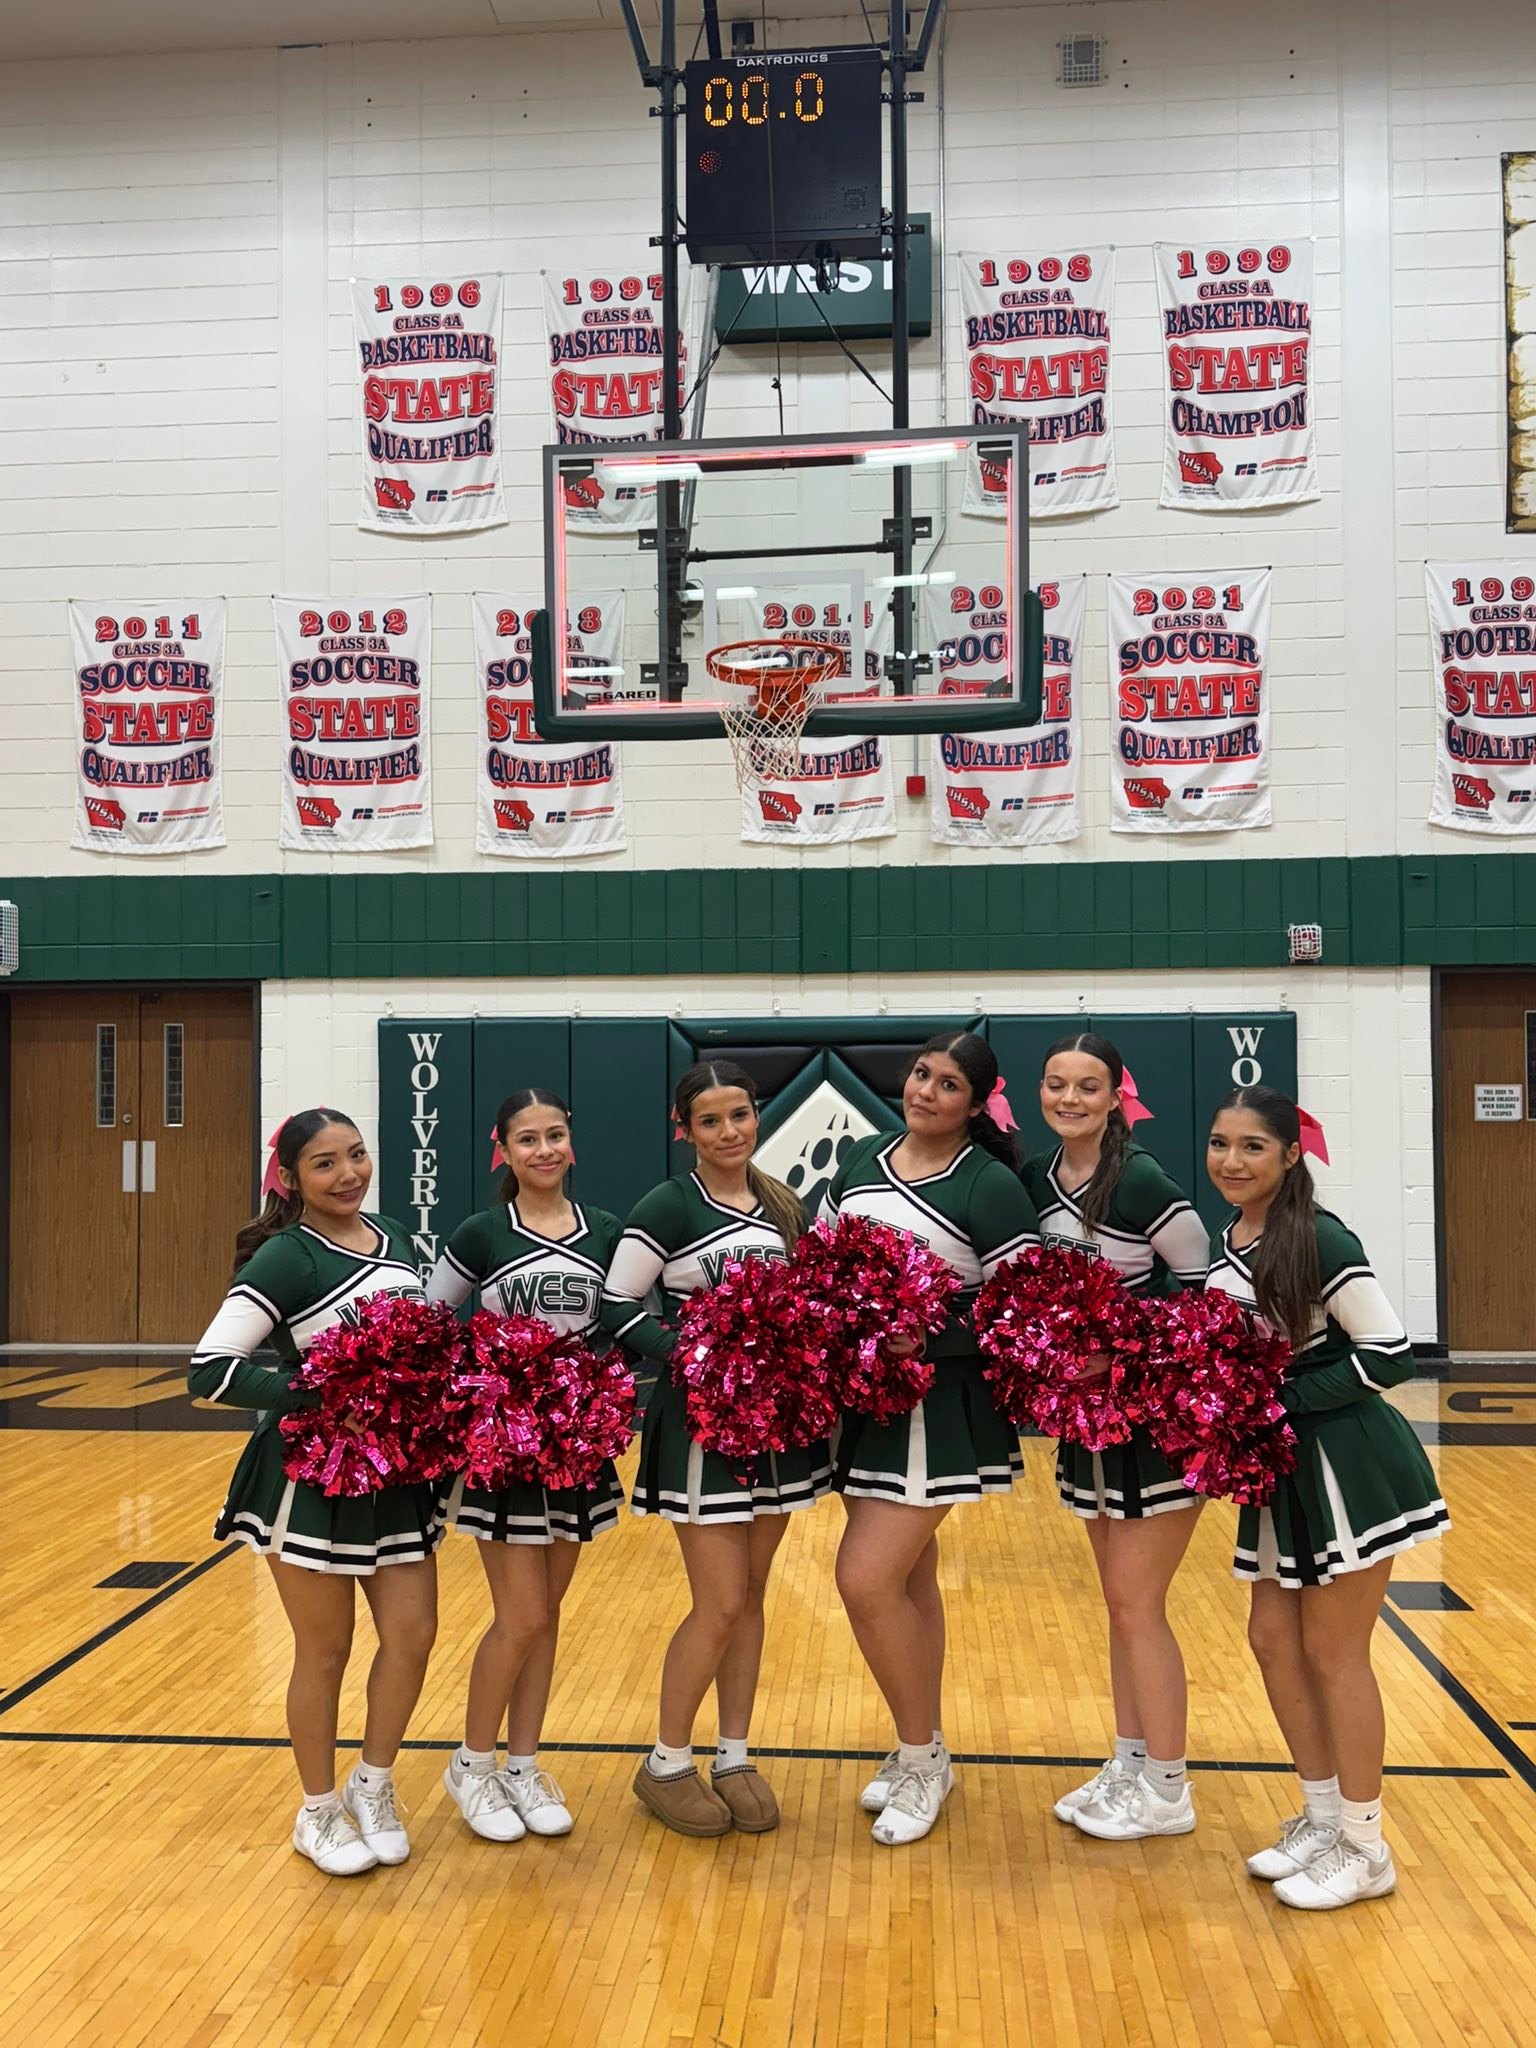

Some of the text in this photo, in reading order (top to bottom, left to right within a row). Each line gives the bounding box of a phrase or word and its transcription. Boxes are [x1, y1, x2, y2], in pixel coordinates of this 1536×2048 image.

[736, 54, 828, 67] DAKTRONICS
[705, 73, 823, 126] 00.0
[980, 254, 1092, 287] 1998
[1177, 246, 1291, 279] 1999
[374, 280, 481, 312] 1996
[1000, 288, 1074, 308] CLASS 4A
[1197, 279, 1273, 299] CLASS 4A
[393, 313, 464, 333] CLASS 4A
[582, 307, 654, 326] CLASS 4A
[966, 307, 1110, 350] BASKETBALL
[1164, 300, 1311, 340] BASKETBALL
[360, 333, 497, 373] BASKETBALL
[550, 327, 687, 366] BASKETBA
[969, 346, 1109, 402] STATE
[1168, 338, 1309, 394] STATE
[363, 369, 494, 422] STATE
[1170, 389, 1307, 438] CHAMPION
[368, 418, 494, 464] QUALIFIER
[982, 462, 1008, 484] IHSA
[1182, 453, 1215, 481] IHSAA
[378, 480, 408, 507] IHSAA
[569, 483, 596, 505] HSAA
[951, 582, 1060, 613] 205
[1133, 584, 1244, 616] 2021
[95, 614, 202, 642] 2011
[300, 609, 408, 638] 2012
[970, 611, 1008, 629] CLAS
[1152, 613, 1227, 631] CLASS 3A
[1470, 605, 1521, 624] CLASS
[112, 641, 185, 659] CLASS 3A
[318, 636, 390, 653] CLASS 3A
[1118, 631, 1262, 676] SOCCER
[79, 660, 213, 697] SOCCER
[290, 655, 420, 692] SOCCER
[603, 690, 657, 700] GARED
[1118, 671, 1262, 722] STATE
[83, 696, 215, 746] STATE
[288, 694, 421, 743] STATE
[940, 727, 1073, 774] QUALIFIER
[1118, 720, 1262, 767] QUALIFIER
[81, 745, 213, 788] QUALIFIER
[289, 743, 421, 787] QUALIFIER
[487, 743, 614, 789] QUALIFIER
[762, 792, 793, 820] IHSAA
[950, 788, 982, 816] IHSAA
[1127, 780, 1162, 807] IHSAA
[1455, 776, 1487, 805] IHSAA
[87, 799, 121, 827] IHSAA
[300, 798, 332, 824] IHSAA
[497, 801, 527, 827] IHSAA
[497, 1271, 602, 1320] WEST
